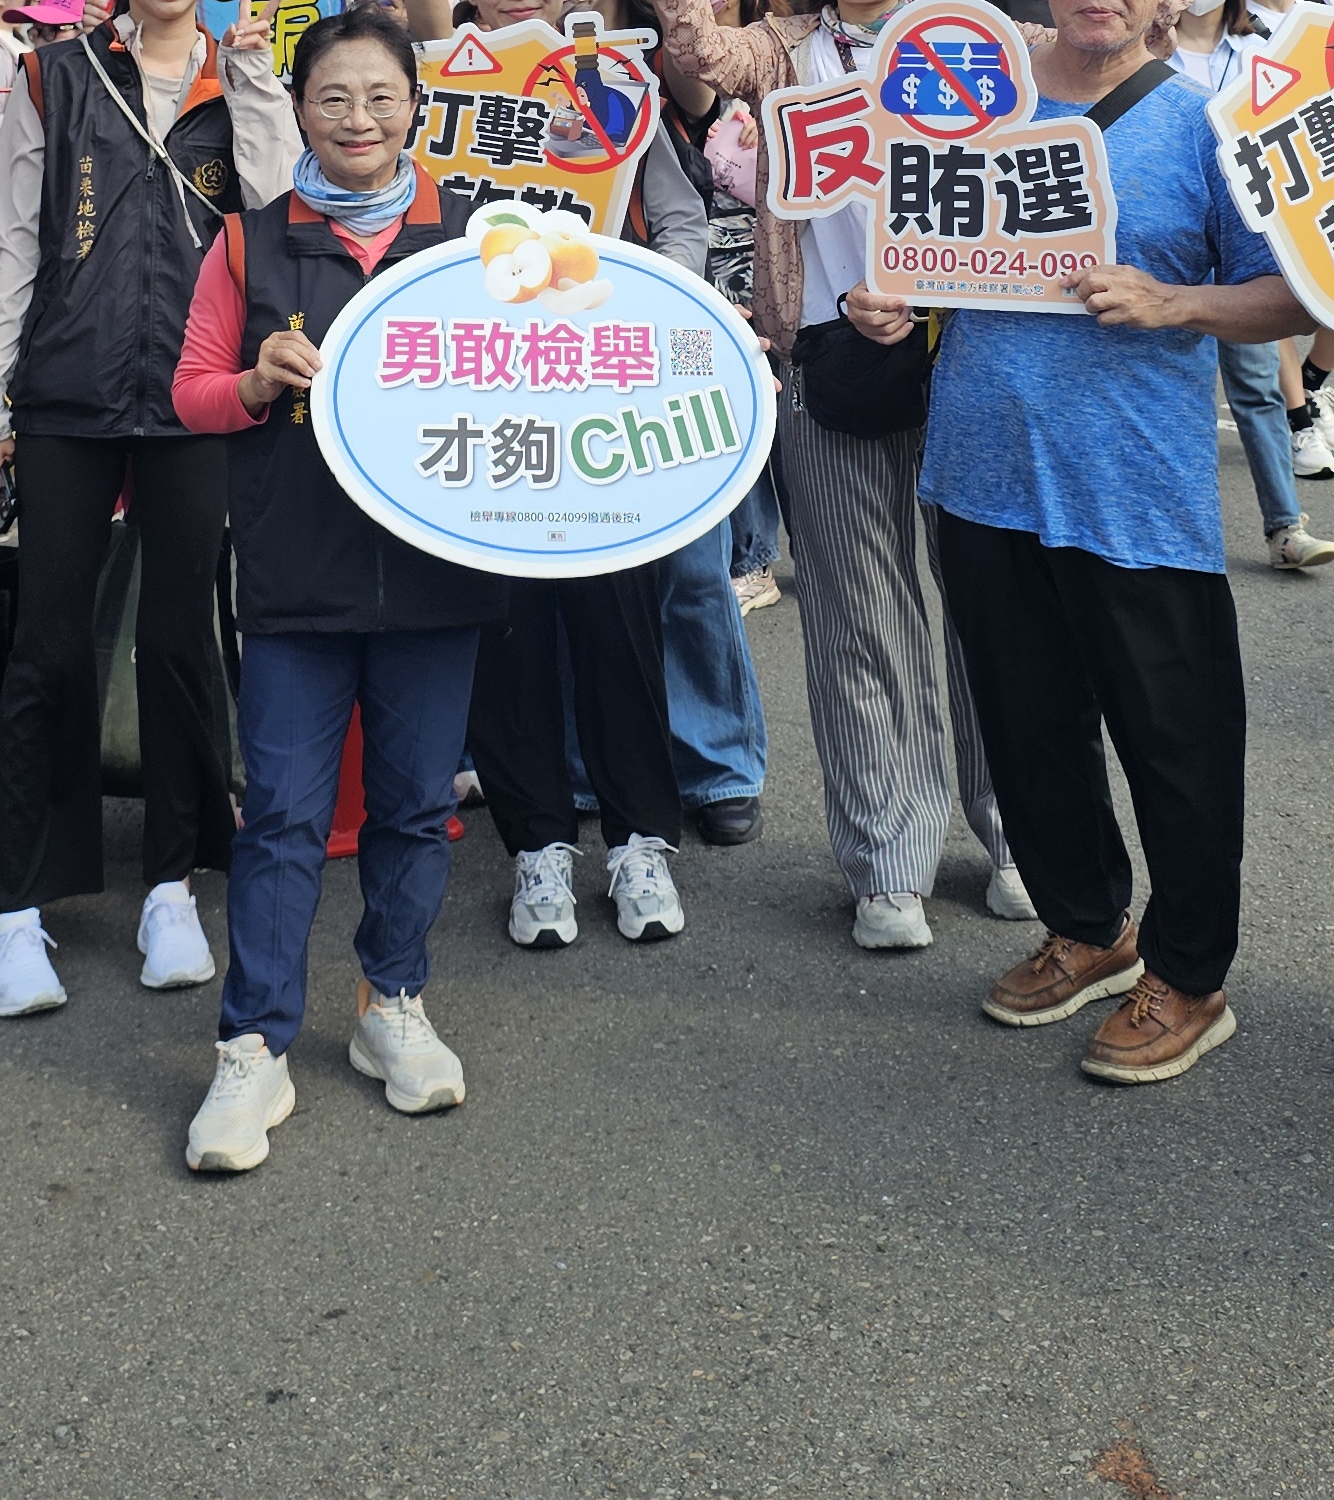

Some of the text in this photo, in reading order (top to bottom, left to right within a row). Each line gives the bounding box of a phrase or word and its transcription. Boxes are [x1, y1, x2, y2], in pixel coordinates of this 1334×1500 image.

[787, 94, 1093, 238] 反賄選
[379, 320, 659, 388] 勇敢檢舉
[419, 388, 738, 485] 才夠 Chill
